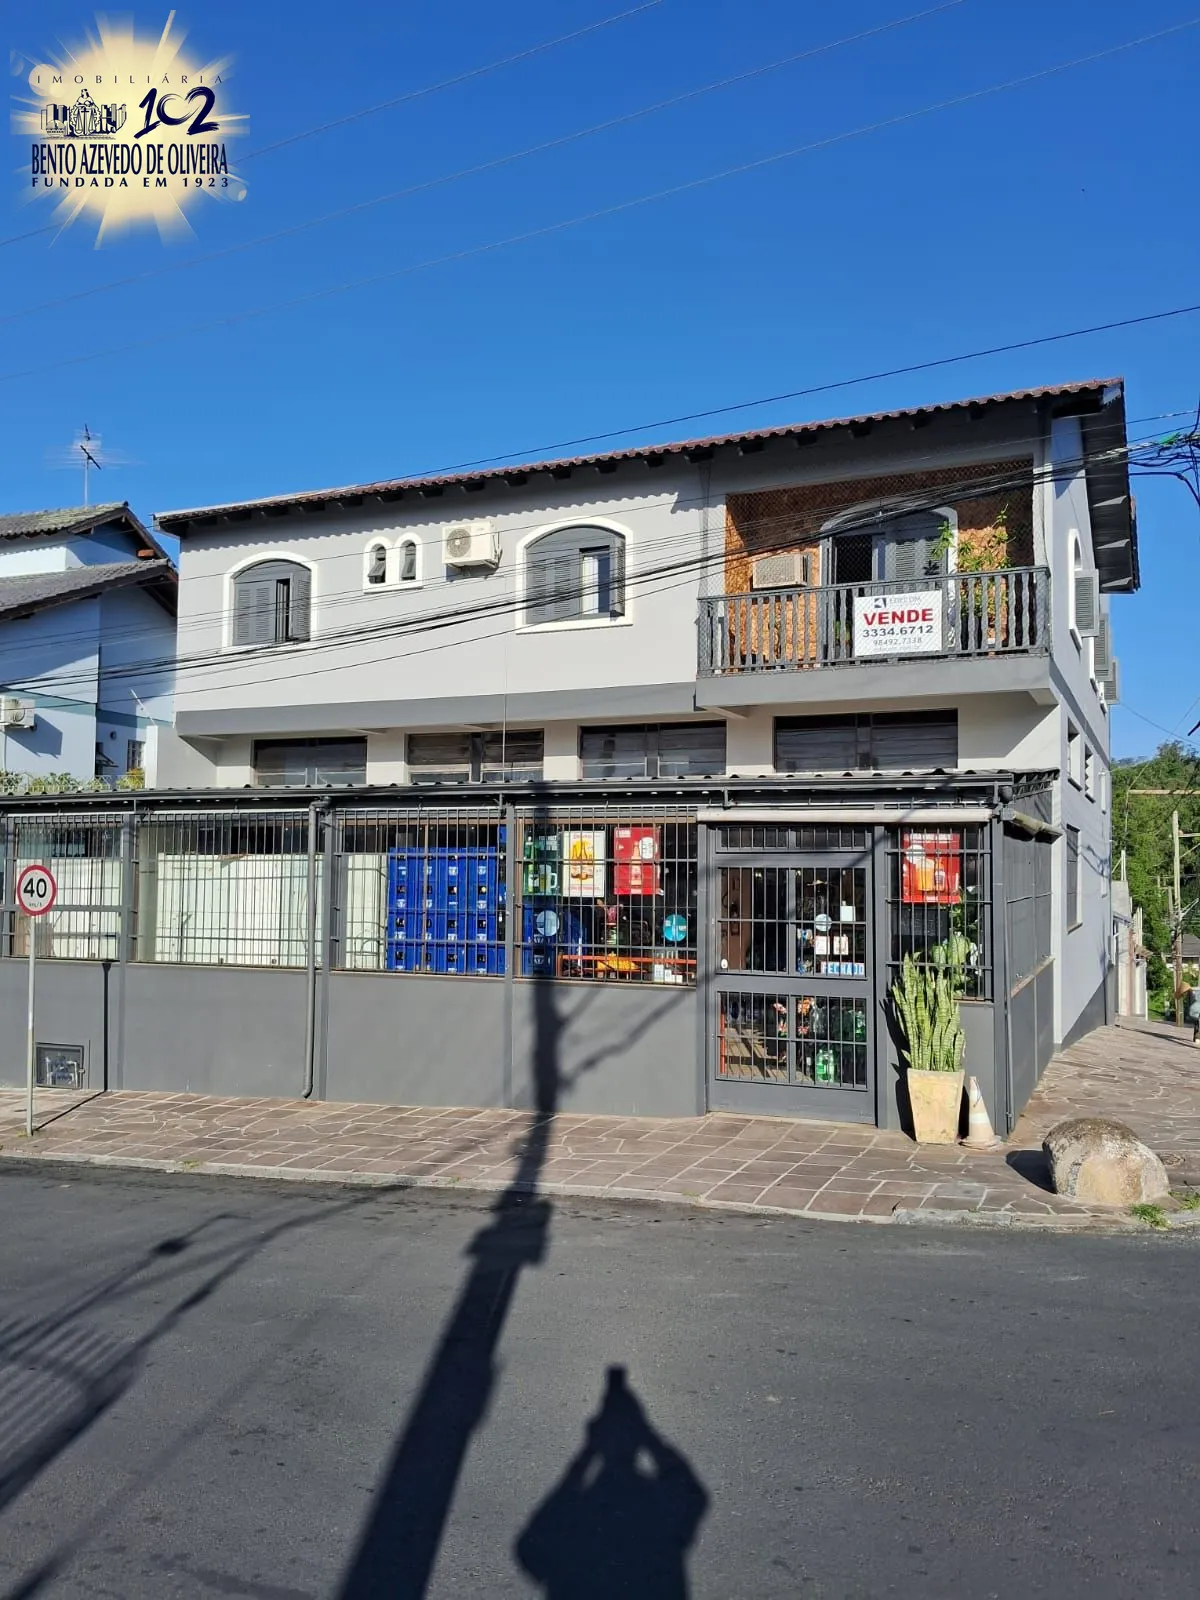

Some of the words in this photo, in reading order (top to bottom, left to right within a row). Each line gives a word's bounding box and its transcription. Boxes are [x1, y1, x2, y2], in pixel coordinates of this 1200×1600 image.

[863, 608, 933, 625] VENDE
[863, 625, 933, 638] 3334.6712
[24, 878, 46, 898] 40
